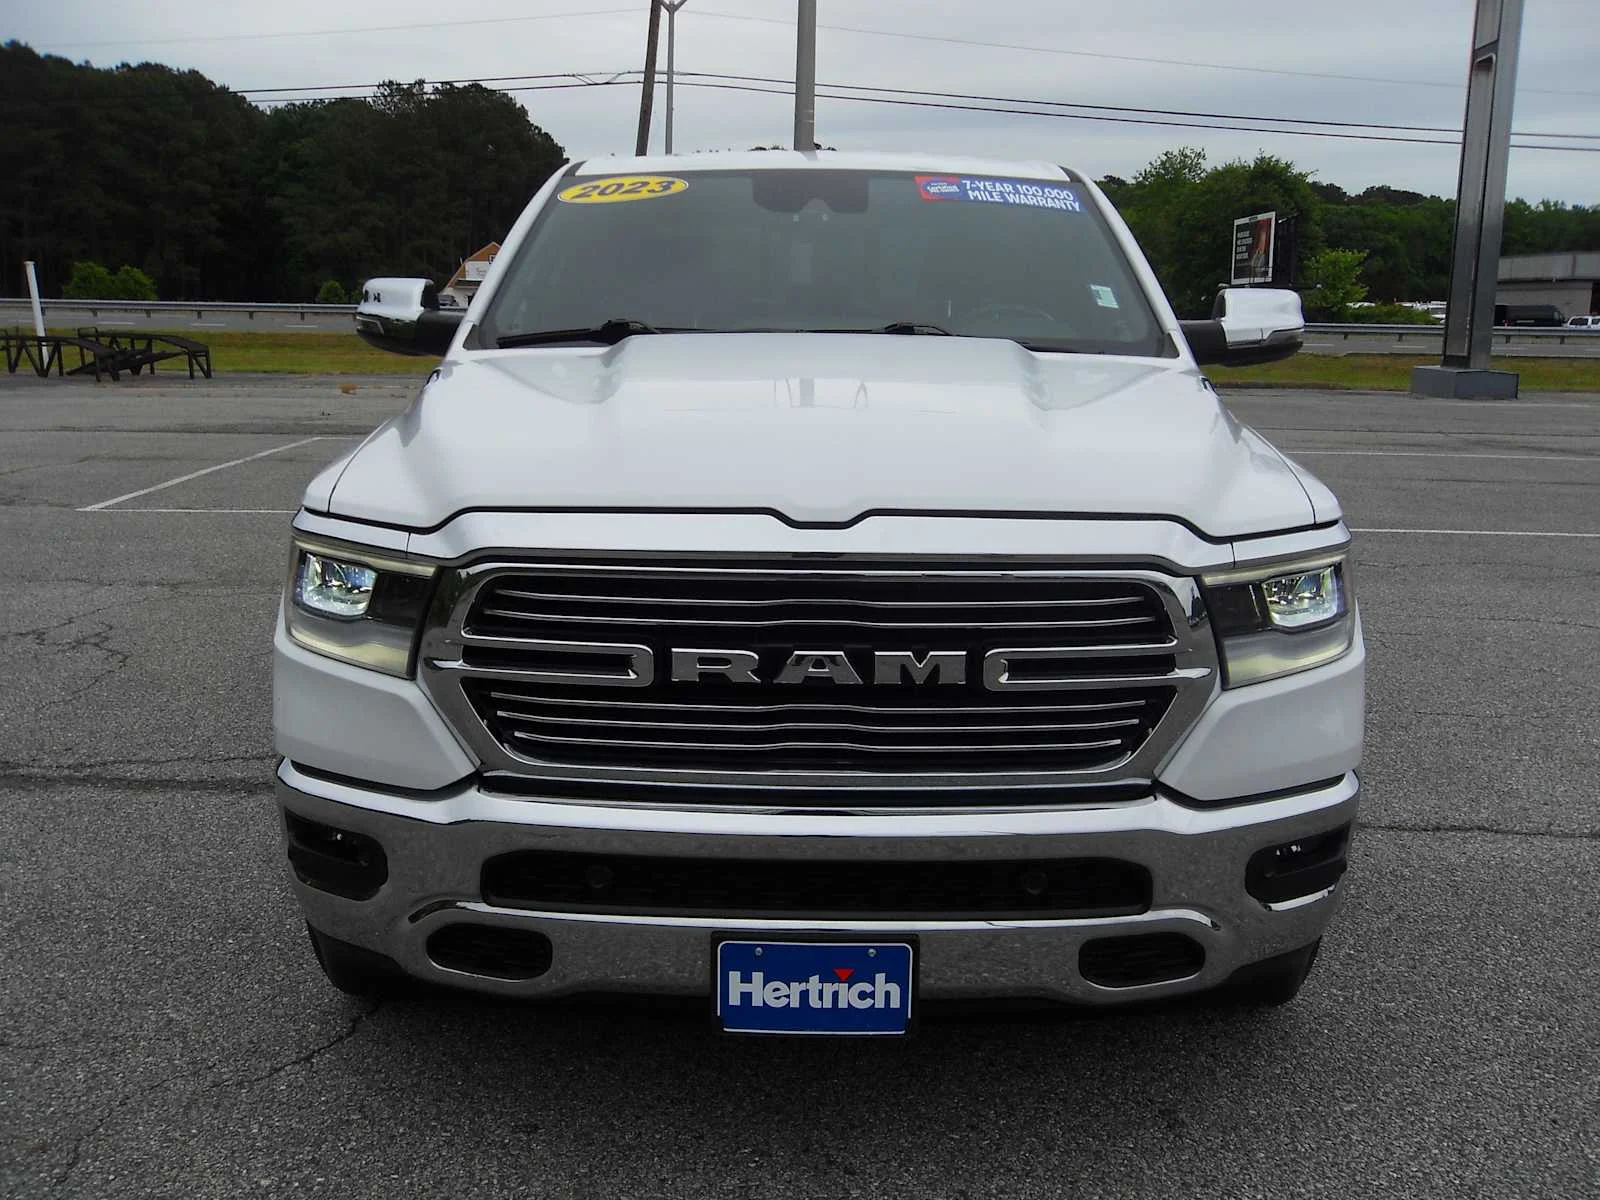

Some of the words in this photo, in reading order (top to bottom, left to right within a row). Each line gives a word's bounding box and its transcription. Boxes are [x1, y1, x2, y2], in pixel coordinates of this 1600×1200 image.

[570, 181, 675, 199] 2023
[962, 180, 1014, 193] 7-YEAR
[967, 190, 1003, 202] MILE
[1004, 193, 1080, 211] WARRANTY
[671, 648, 967, 684] RAM
[728, 968, 901, 1009] Hertrich
